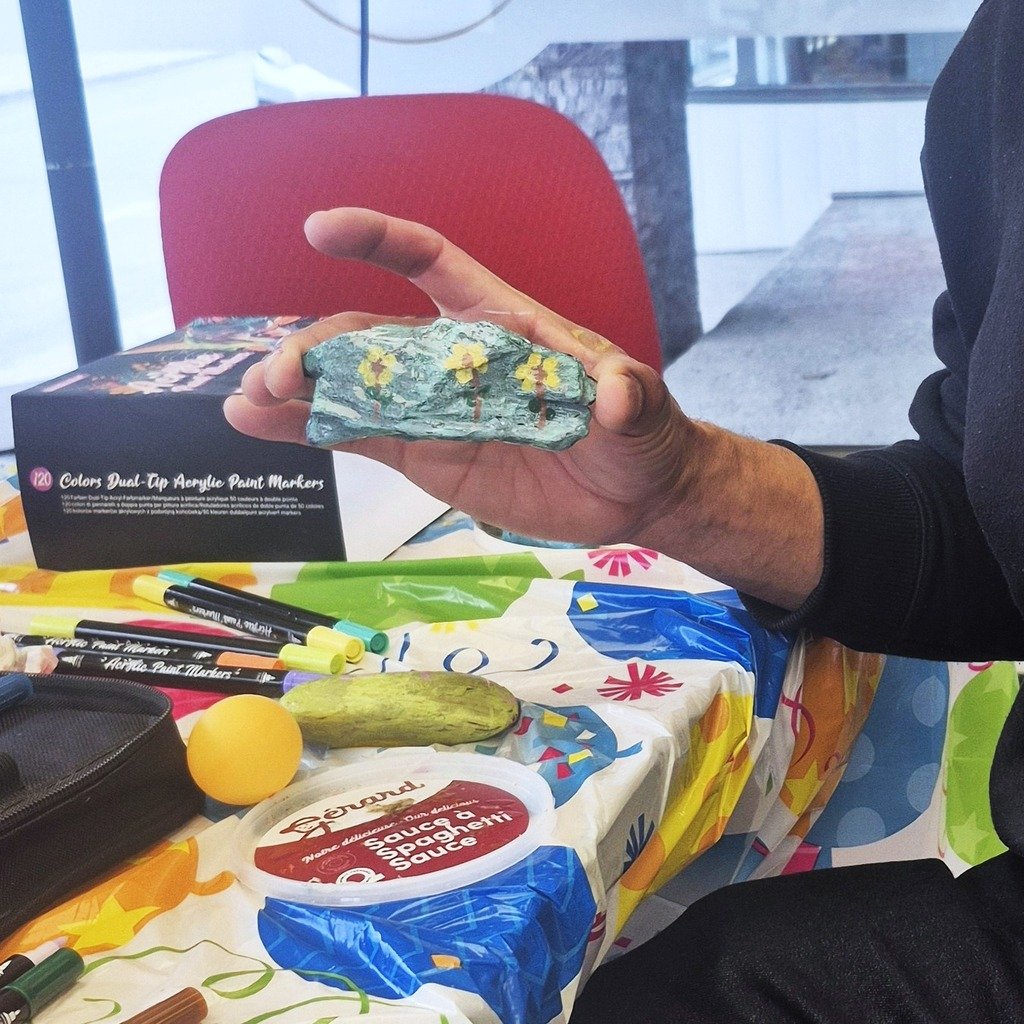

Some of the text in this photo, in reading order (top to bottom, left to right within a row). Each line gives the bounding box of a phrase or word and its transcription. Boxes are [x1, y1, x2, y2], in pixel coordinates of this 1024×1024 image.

[33, 471, 324, 493] 120 Colors Dual-Tip Acrylic Paint Markers
[122, 639, 170, 656] Markers
[103, 656, 233, 680] Acrylic Paint Markers
[363, 810, 476, 850] Sauce à
[376, 810, 513, 860] Spaghetti
[301, 844, 340, 865] Notre
[388, 837, 478, 871] Sauce
